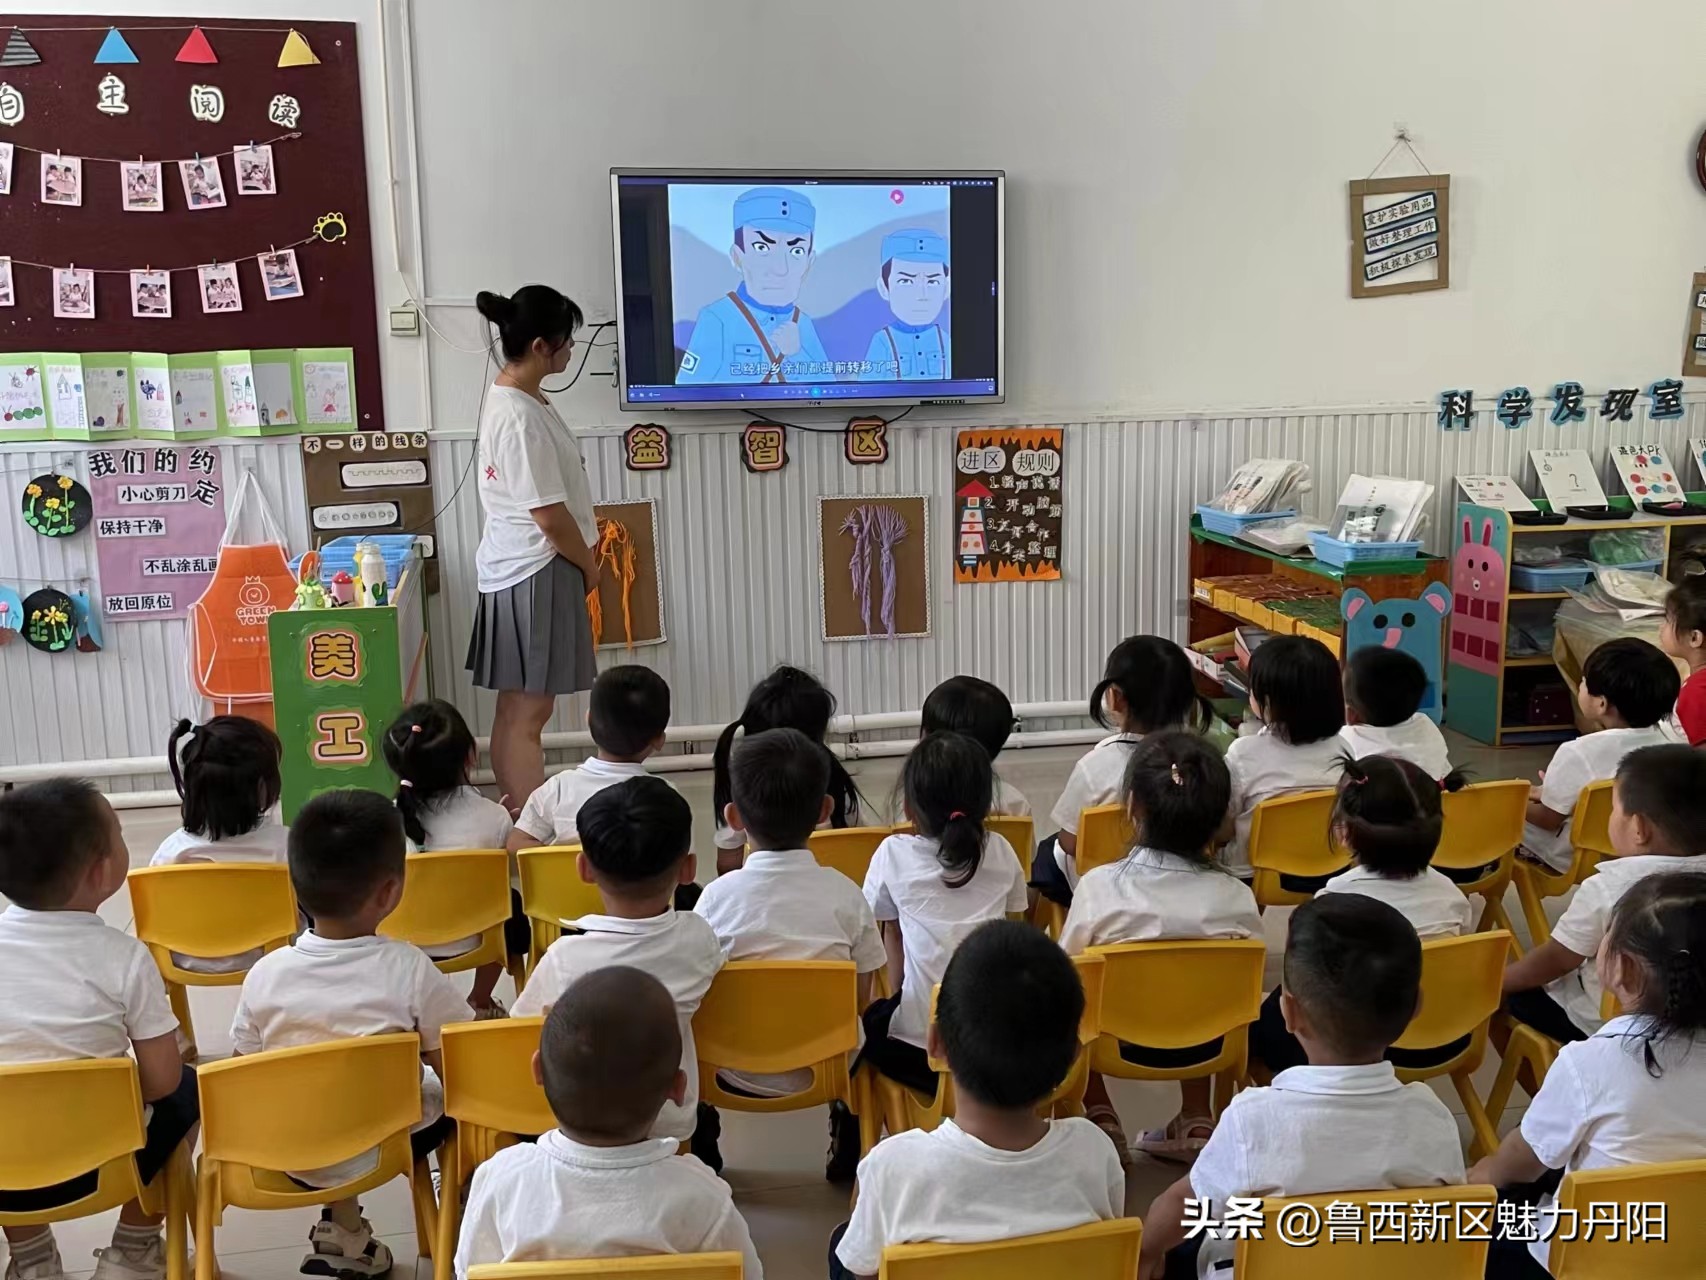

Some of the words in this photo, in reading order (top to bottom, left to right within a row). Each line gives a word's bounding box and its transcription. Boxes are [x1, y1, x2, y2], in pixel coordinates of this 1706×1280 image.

[0, 79, 297, 126] 自主阅读
[1367, 197, 1432, 227] 爱护实验用品
[1369, 220, 1434, 249] 做好整理工作
[1369, 245, 1436, 276] 积极探索发现
[1440, 380, 1684, 429] 科学发现室
[307, 434, 425, 451] 不一样的线条
[630, 423, 883, 465] 益智区
[121, 486, 186, 502] 小心剪刀
[99, 518, 164, 535] 保持干净
[144, 558, 217, 573] 不乱涂乱画
[108, 594, 172, 612] 放回原位
[236, 605, 277, 617] GREEN
[239, 615, 268, 626] TOW
